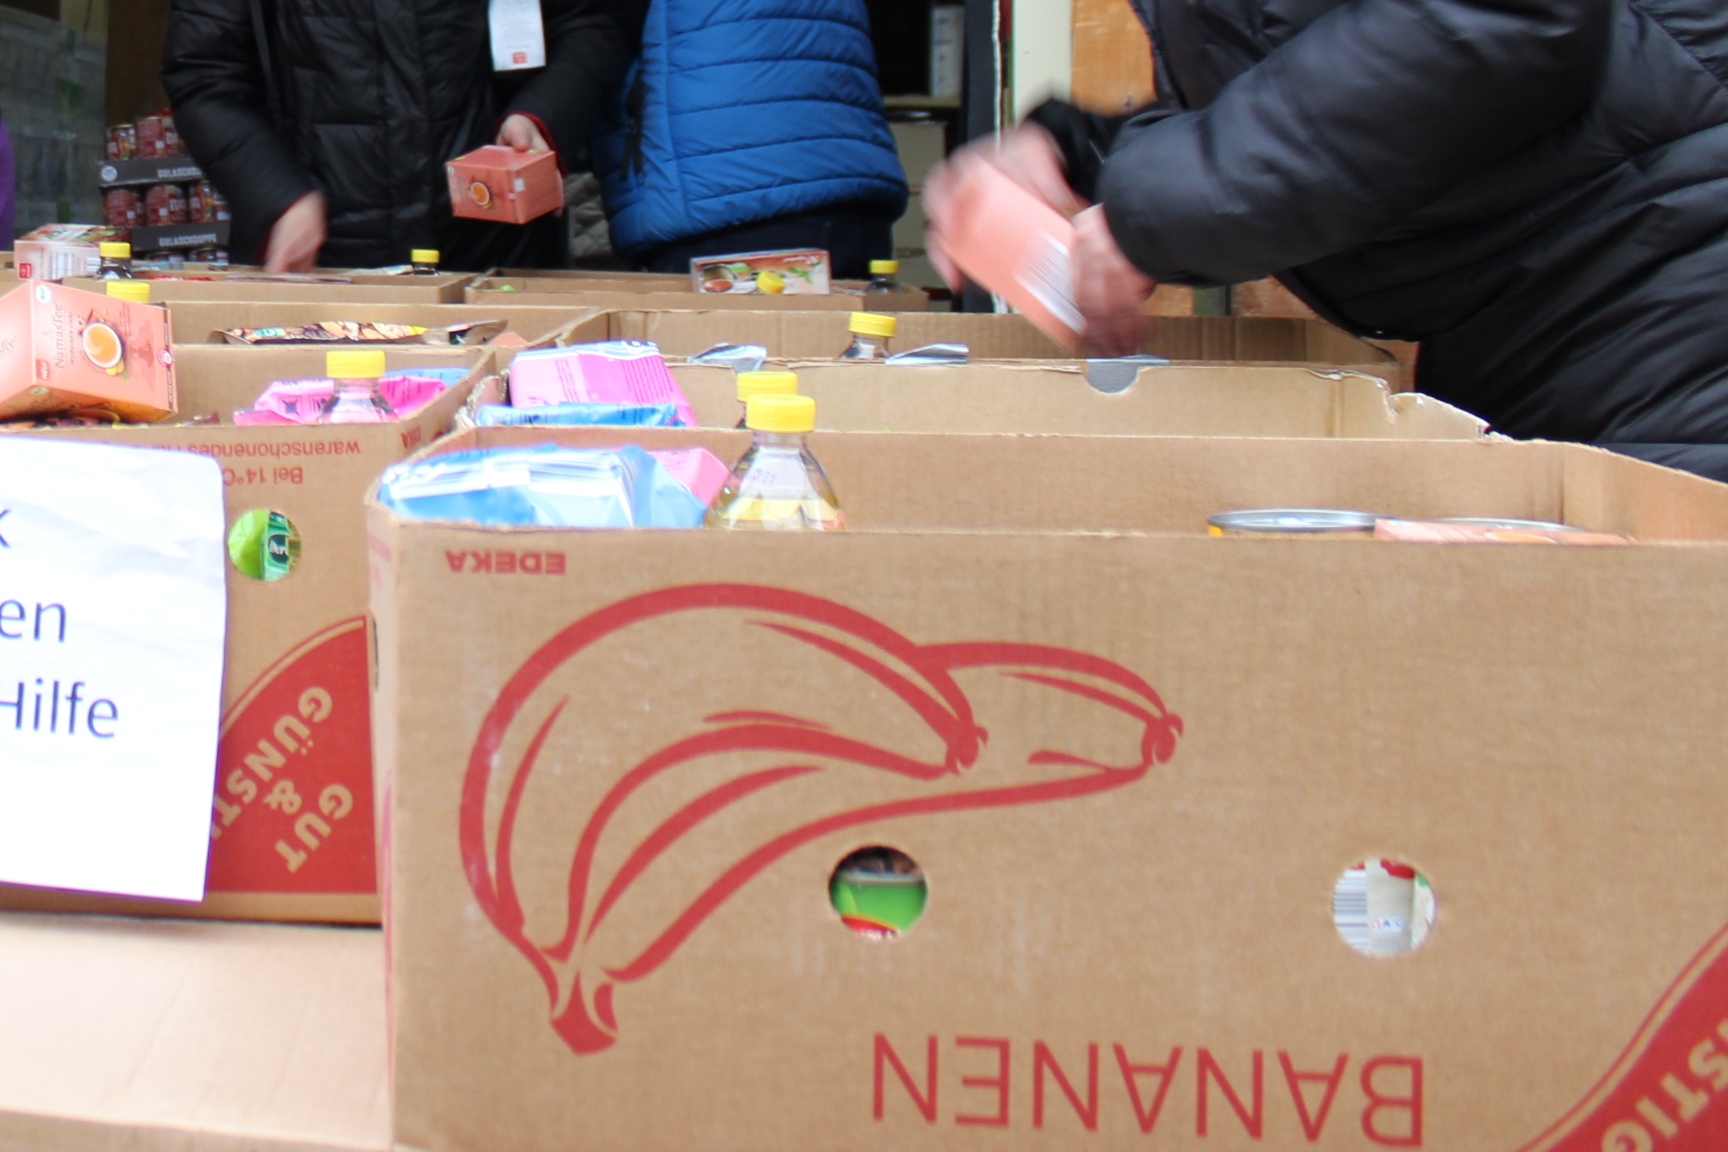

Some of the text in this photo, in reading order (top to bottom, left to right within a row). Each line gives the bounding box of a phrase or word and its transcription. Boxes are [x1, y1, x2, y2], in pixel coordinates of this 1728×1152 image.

[269, 466, 304, 485] Bei
[444, 549, 566, 575] EDEKA
[212, 686, 334, 841] GÜNST
[263, 779, 303, 816] &
[274, 784, 354, 874] GUT
[874, 1032, 1424, 1150] BANANEN
